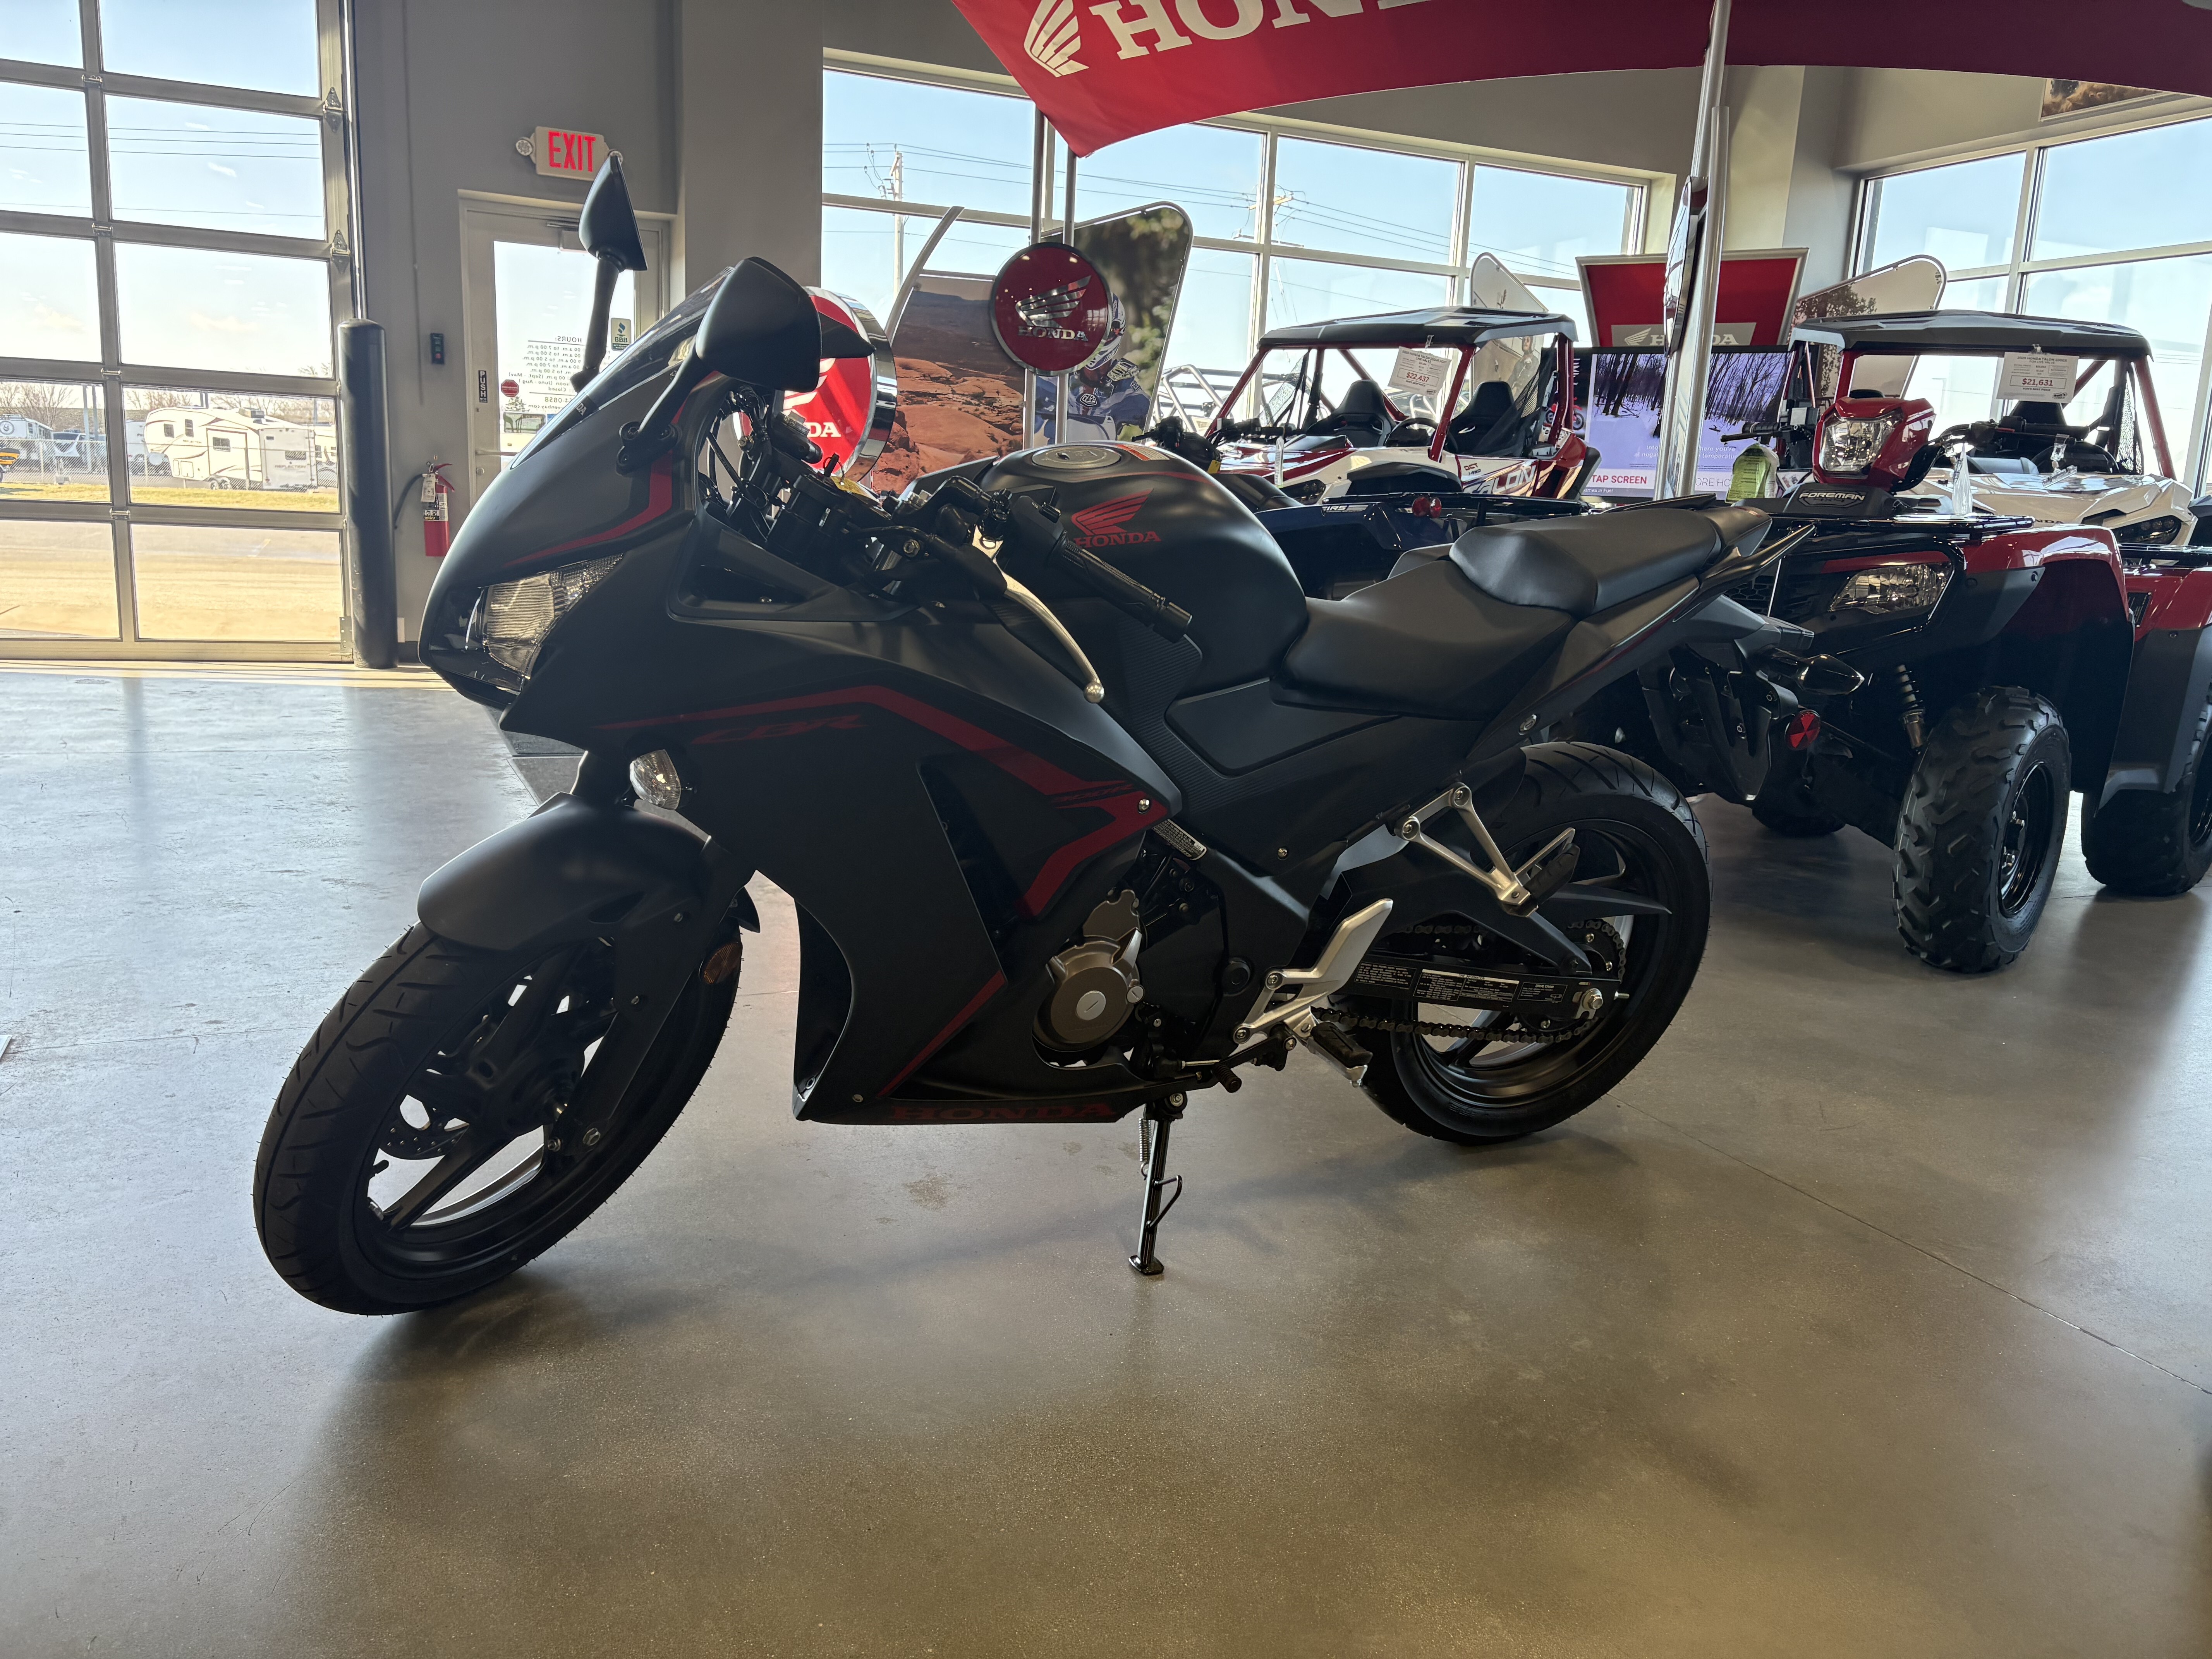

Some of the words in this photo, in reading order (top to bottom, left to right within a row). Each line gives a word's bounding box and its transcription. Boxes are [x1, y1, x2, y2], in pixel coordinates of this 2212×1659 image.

[548, 130, 596, 172] EXIT
[1018, 326, 1089, 341] HONDA
[1649, 334, 1739, 345] HDA
[1406, 372, 1429, 383] $22,437
[2022, 378, 2053, 386] $21,631
[1611, 476, 1647, 484] SCREEN
[1799, 492, 1865, 501] FOREMAN
[1073, 531, 1161, 548] HONDA
[691, 714, 869, 744] CBR
[891, 1103, 1116, 1120] HONDA
